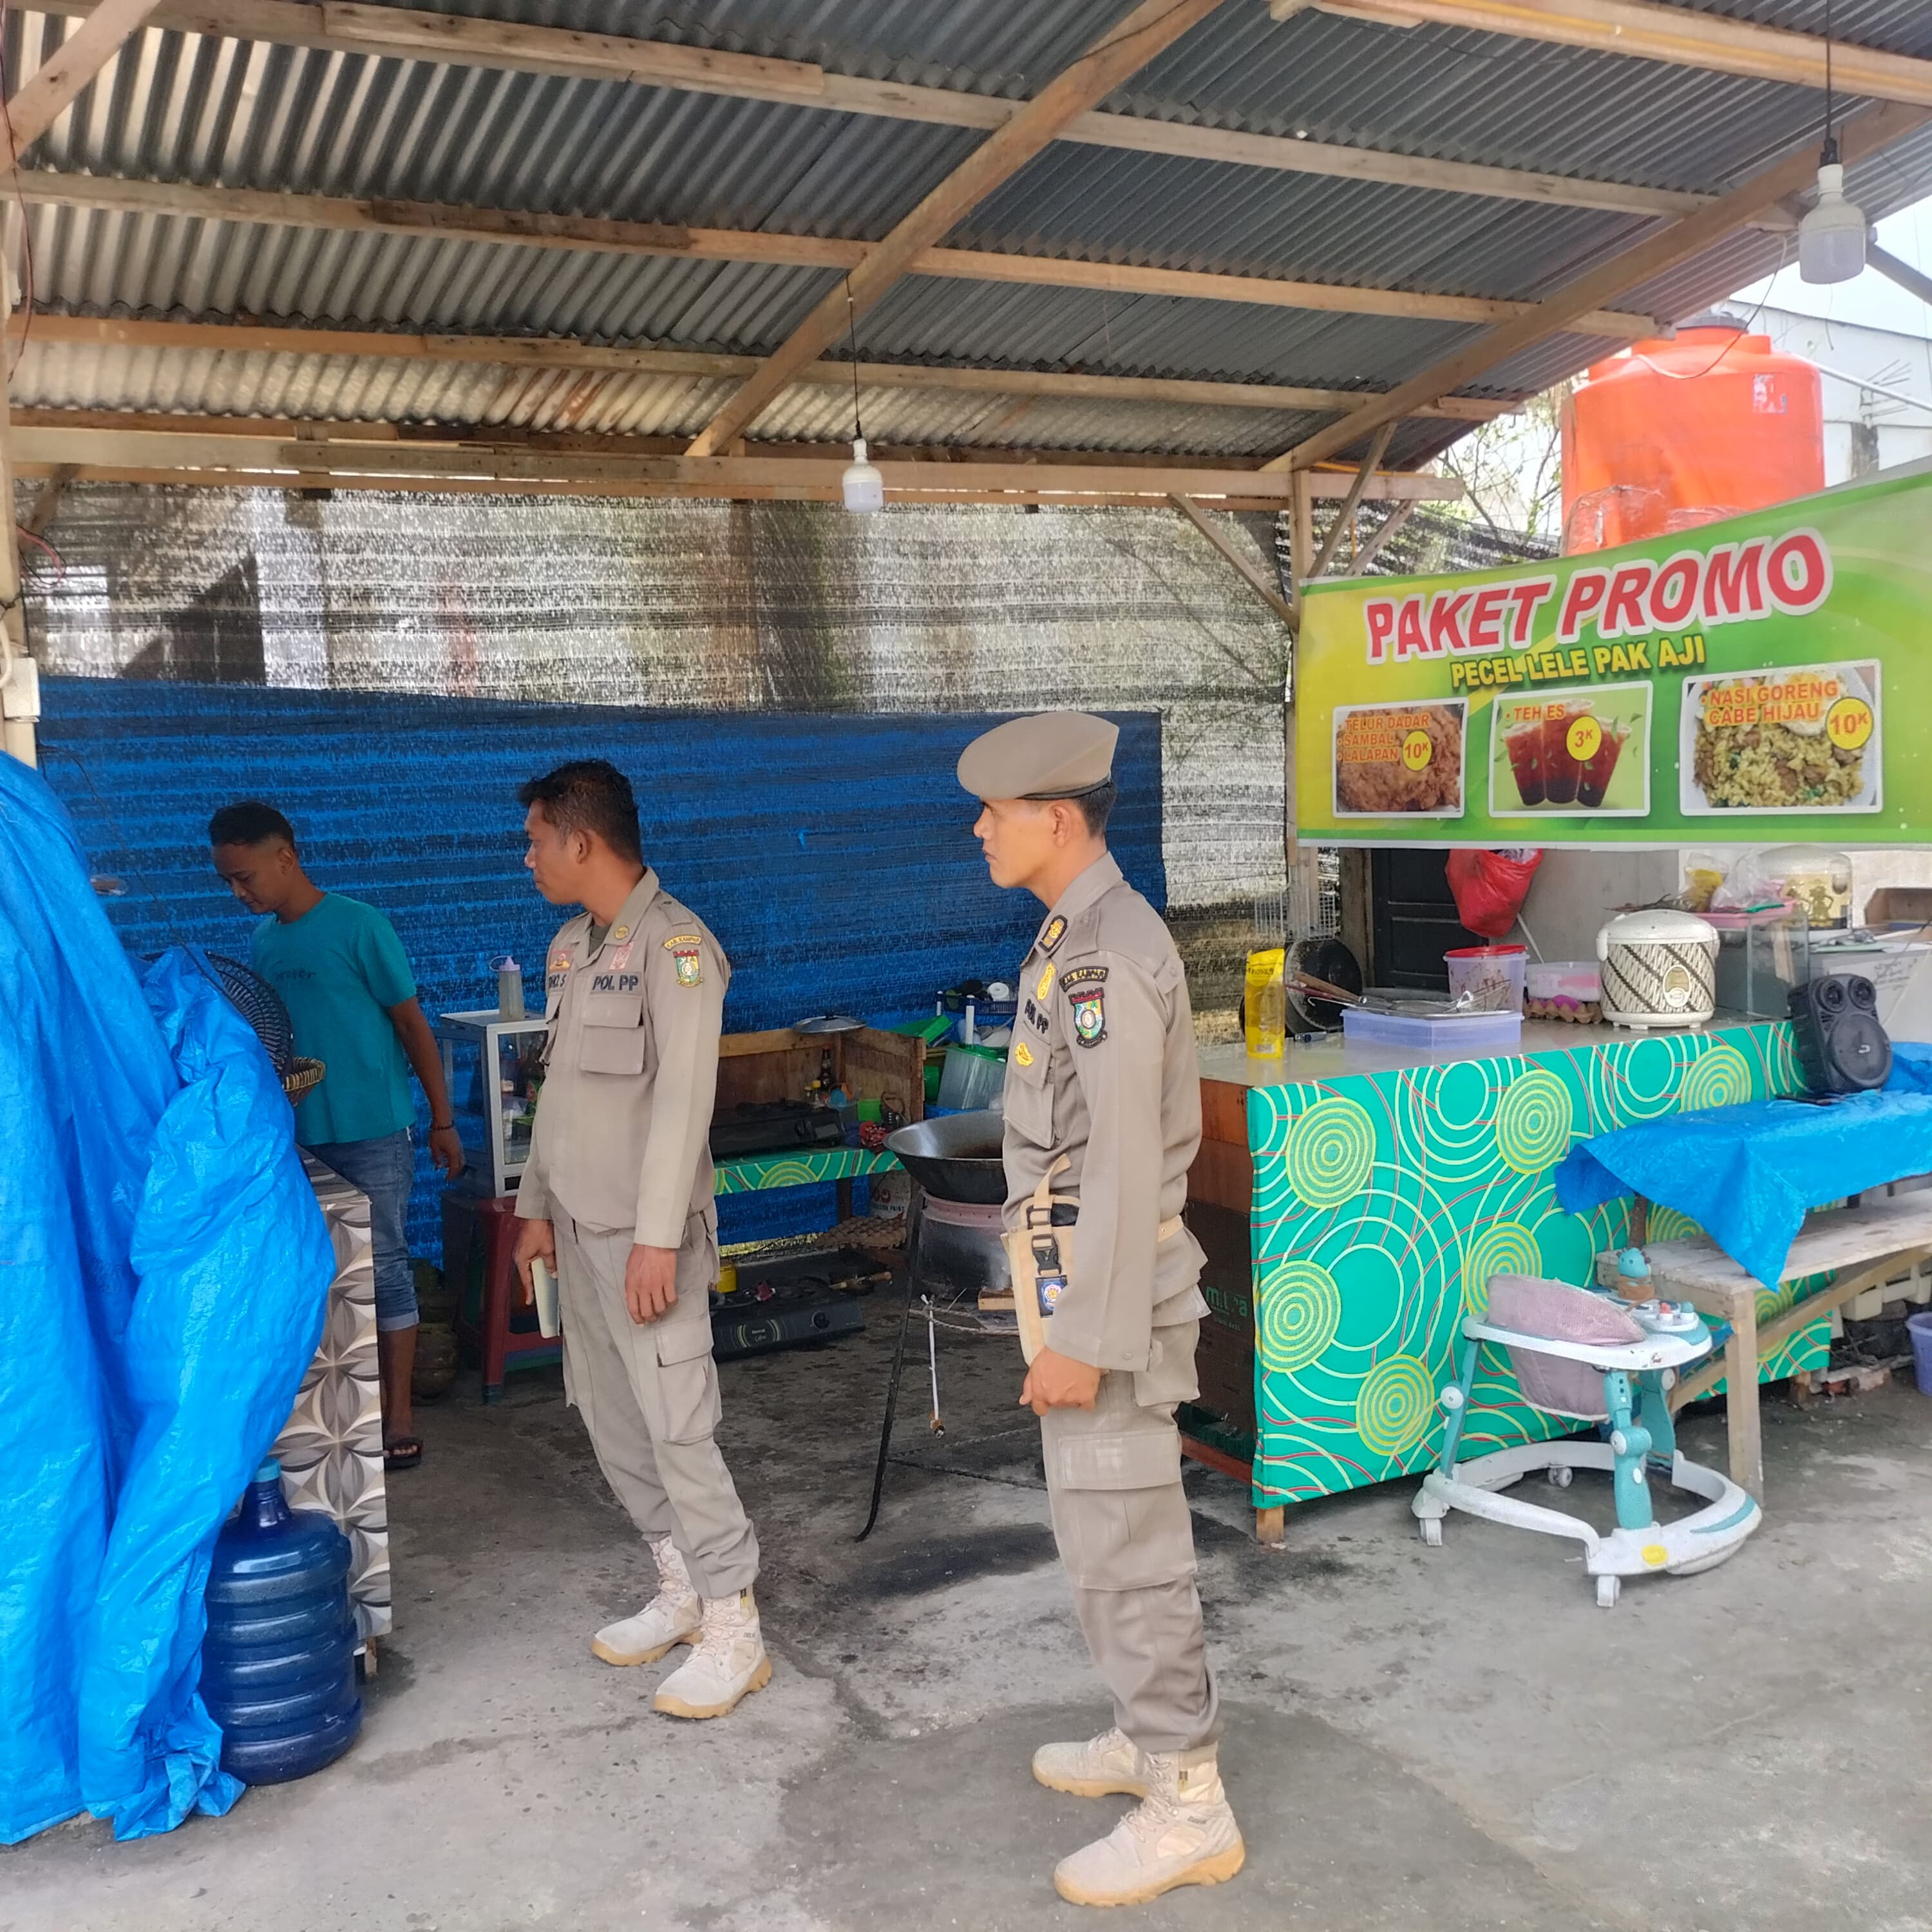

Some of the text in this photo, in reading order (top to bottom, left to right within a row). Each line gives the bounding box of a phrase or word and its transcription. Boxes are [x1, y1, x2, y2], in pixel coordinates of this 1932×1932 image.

[1366, 535, 1825, 659] PAKET PROMO
[1450, 635, 1706, 688] PECEL LELE PAK AJI
[1710, 679, 1839, 706] NASI GORENG
[1514, 703, 1566, 721] TEH ES
[1709, 703, 1820, 725] CABE HIJAU
[1344, 714, 1430, 732] TELUR DADAR
[1343, 733, 1394, 747] SAMBAL
[1343, 748, 1398, 762] LALAPAN
[592, 974, 639, 991] POL PP
[1036, 1013, 1049, 1034] PP
